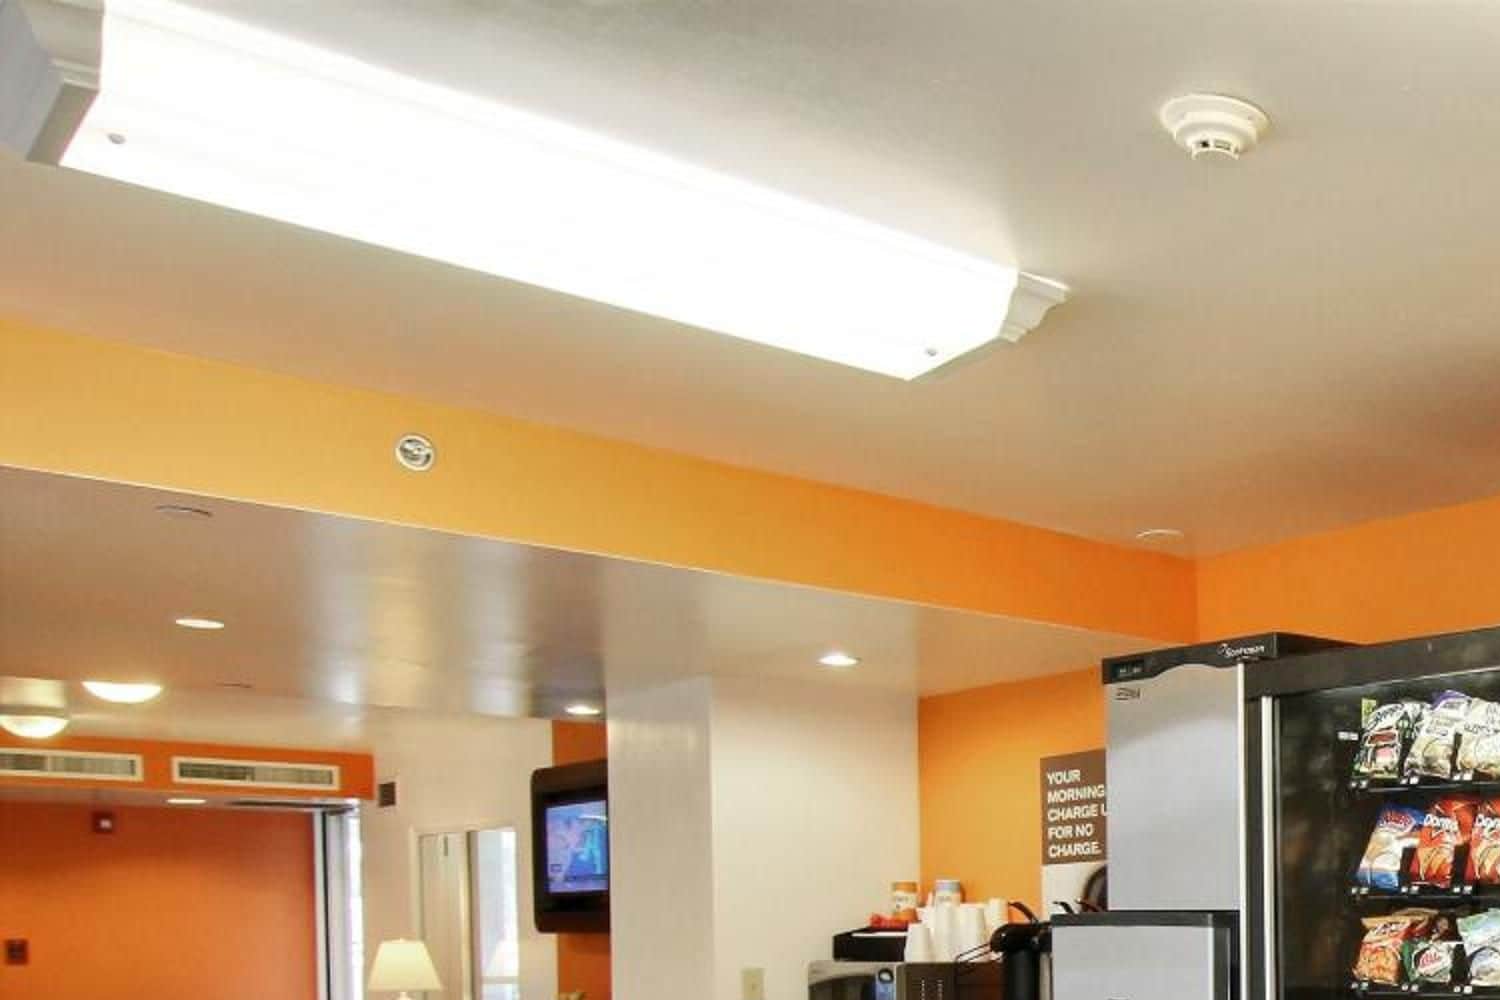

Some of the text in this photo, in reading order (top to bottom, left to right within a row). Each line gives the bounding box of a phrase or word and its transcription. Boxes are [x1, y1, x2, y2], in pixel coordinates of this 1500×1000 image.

[1046, 769, 1081, 785] YOUR
[1047, 784, 1105, 803] MORNING
[1047, 803, 1099, 822] CHARGE
[1047, 823, 1094, 840] FOR NO
